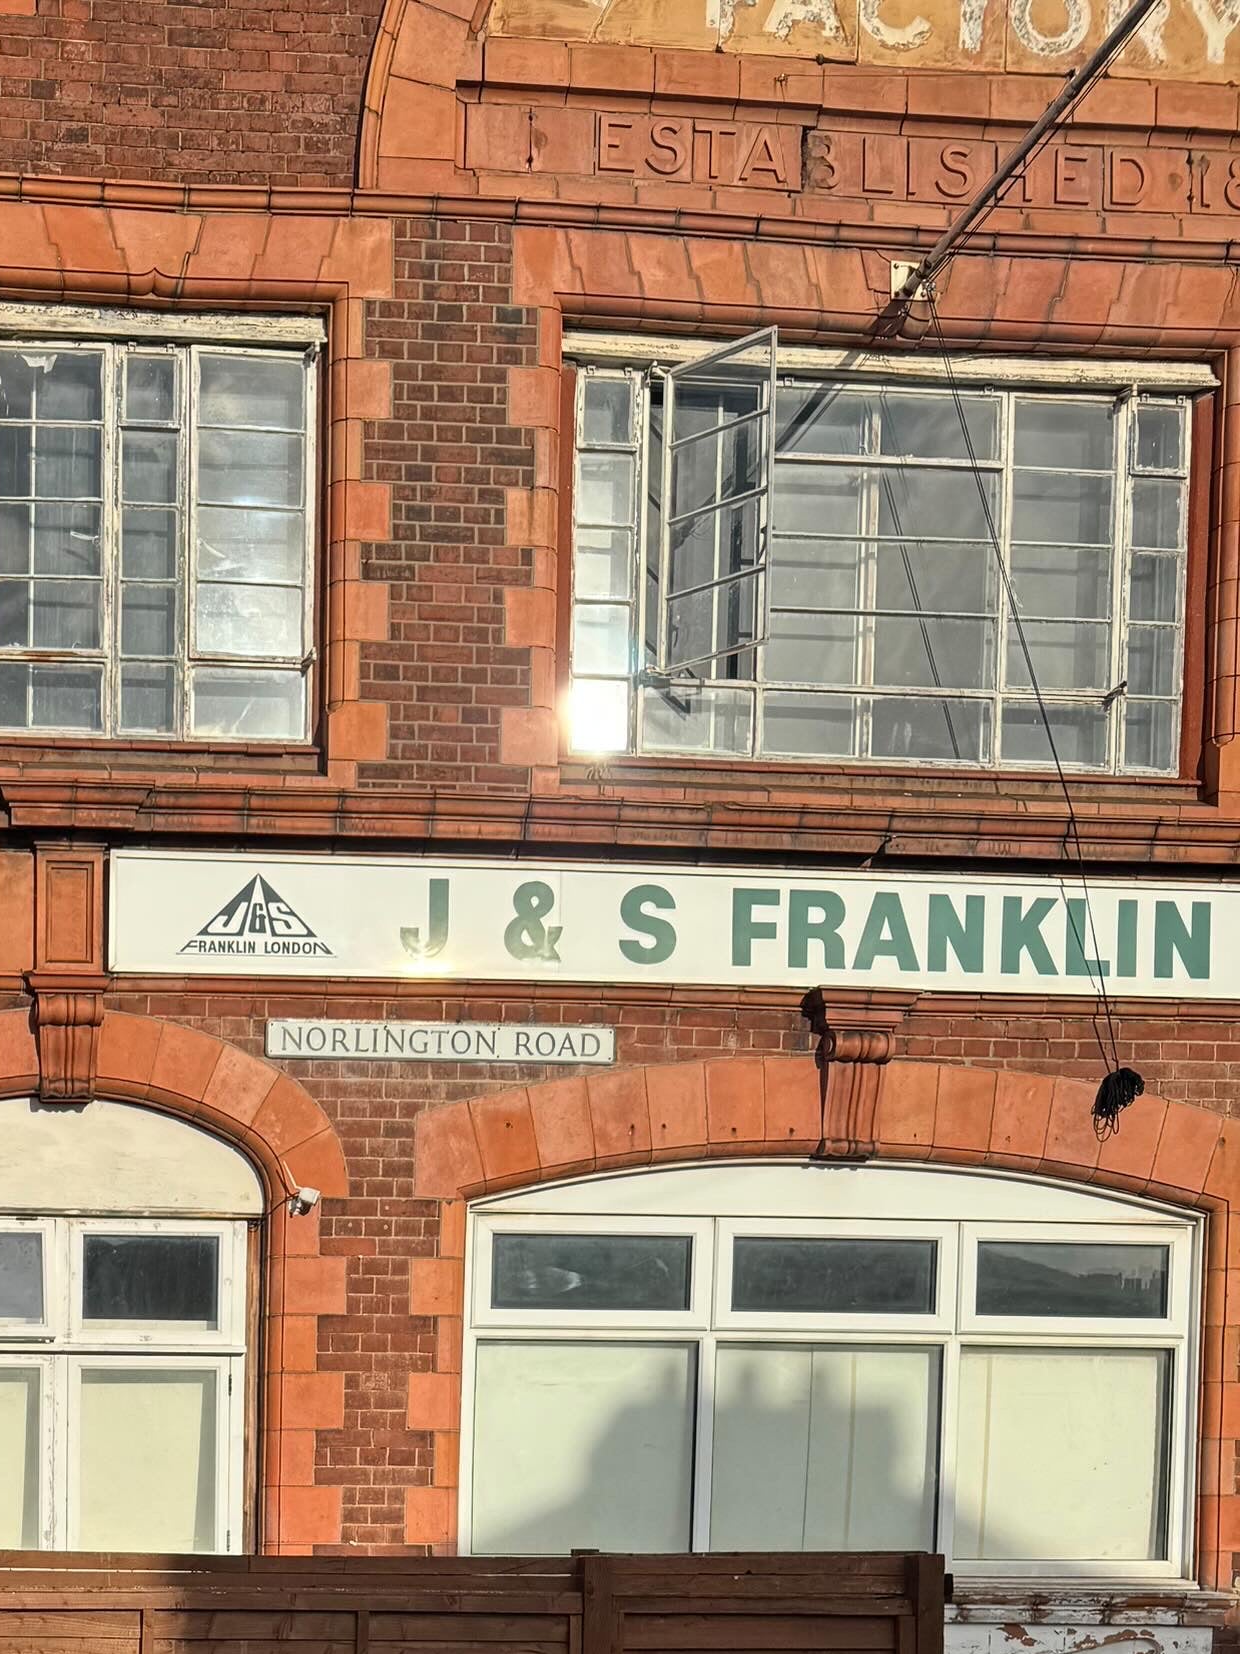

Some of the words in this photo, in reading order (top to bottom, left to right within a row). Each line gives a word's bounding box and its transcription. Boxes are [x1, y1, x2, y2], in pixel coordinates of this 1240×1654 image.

[399, 878, 450, 958] J
[503, 880, 563, 962] &
[618, 883, 678, 965] S
[731, 887, 1212, 980] FRANKLIN
[180, 940, 256, 954] FRANKLIN
[264, 941, 334, 956] LONDON
[281, 1026, 497, 1055] NORLINGTON
[514, 1031, 602, 1057] ROAD
